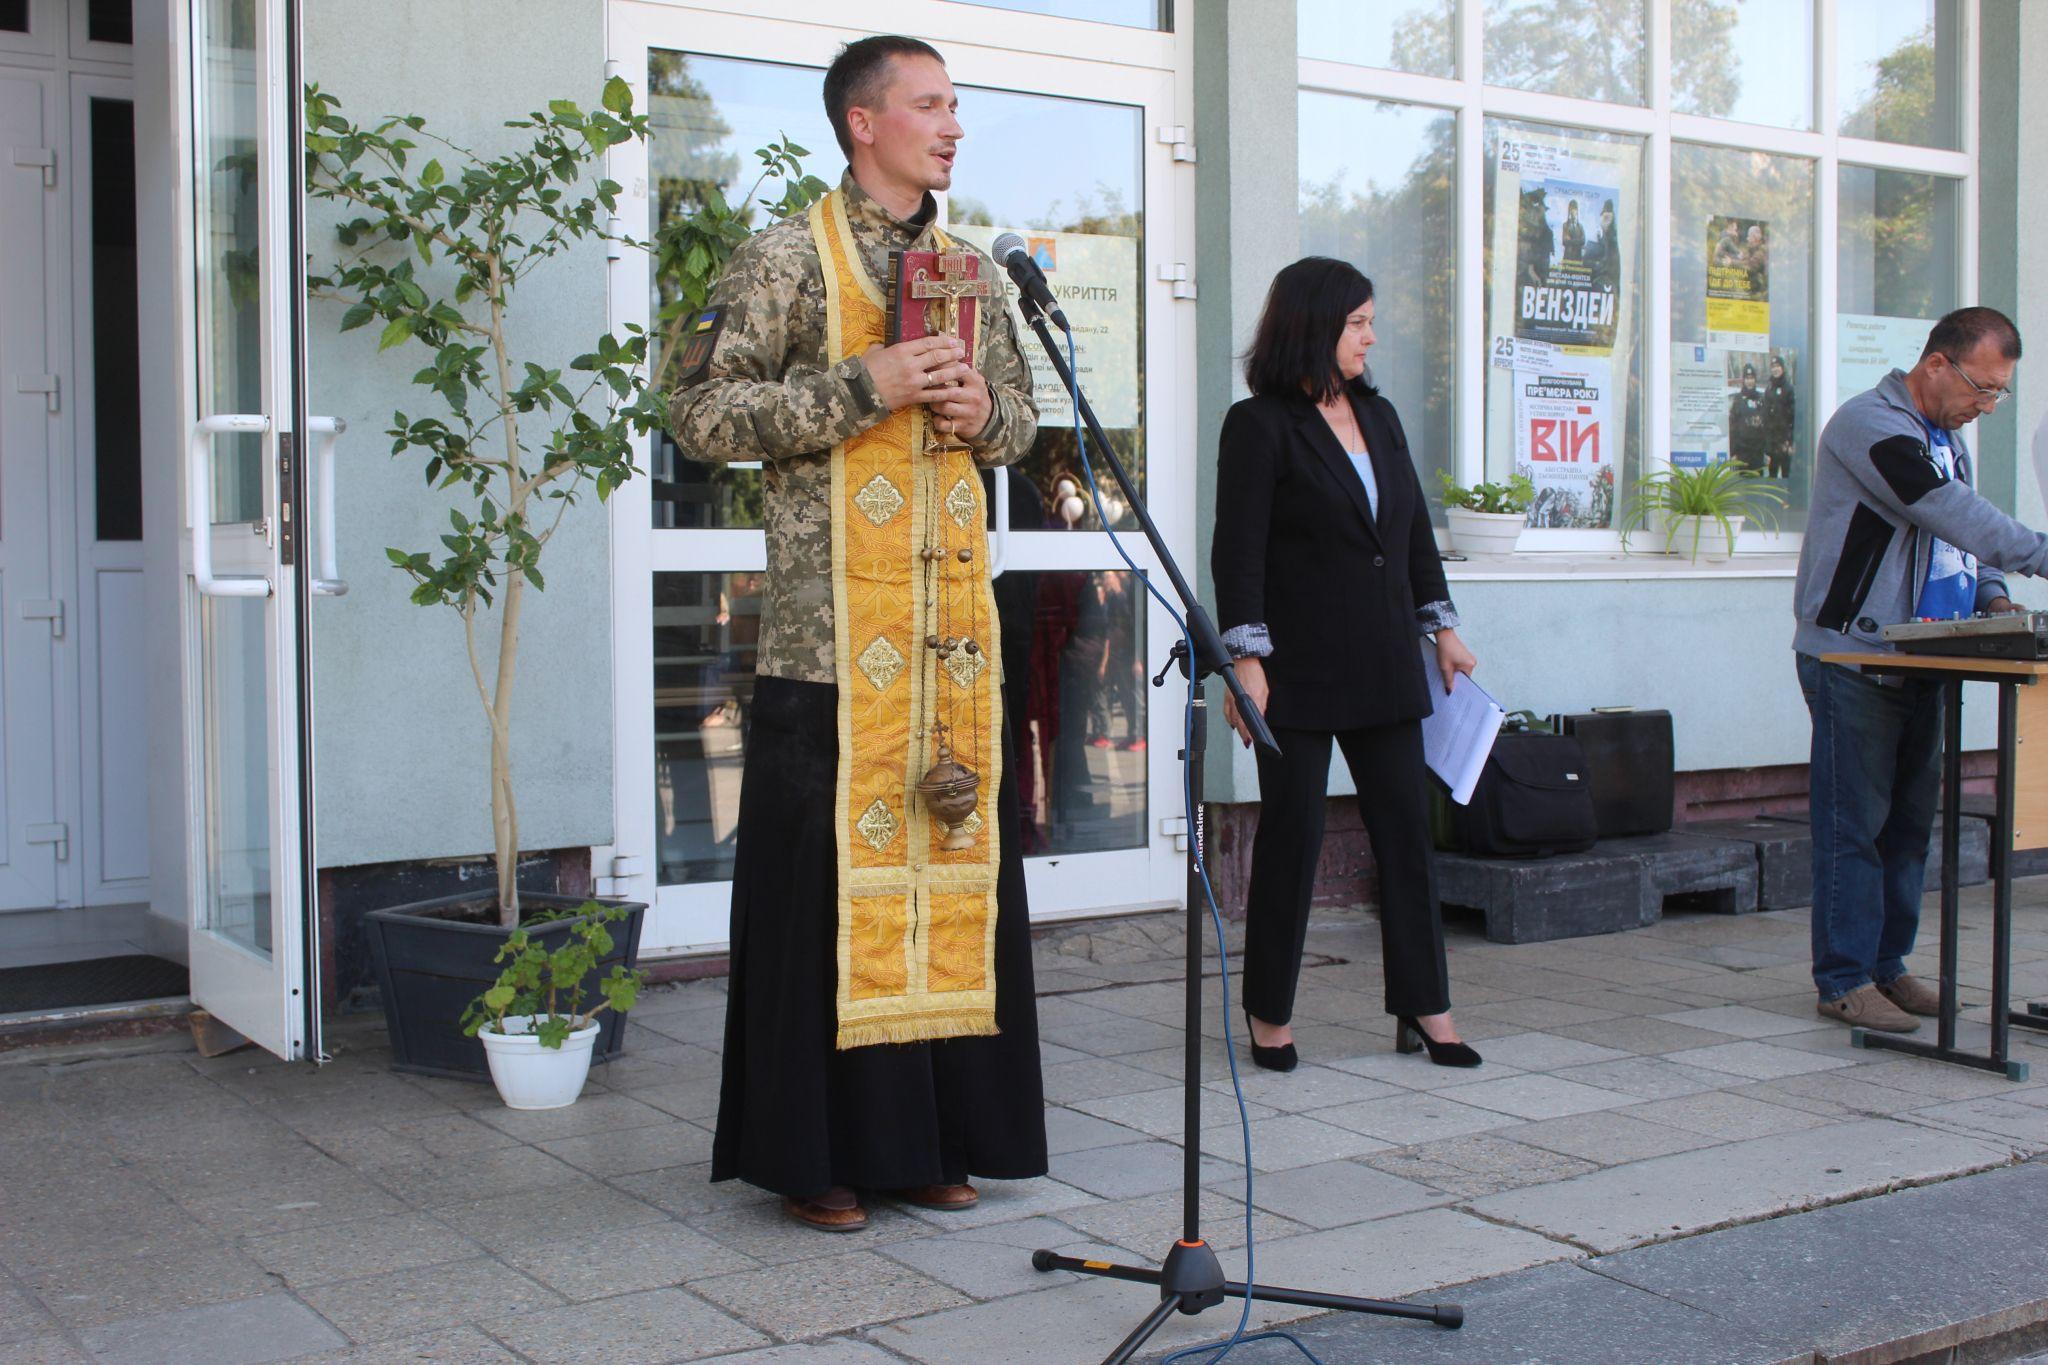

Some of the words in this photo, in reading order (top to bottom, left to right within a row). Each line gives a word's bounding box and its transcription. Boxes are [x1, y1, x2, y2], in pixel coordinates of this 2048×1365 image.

[1502, 141, 1520, 161] 25
[1053, 285, 1117, 302] УКРИТТЯ
[1522, 285, 1614, 330] ВЕНЗДЕЙ
[1072, 325, 1098, 334] айдану,
[1495, 336, 1514, 357] 25
[1573, 389, 1598, 400] РОКУ
[1530, 406, 1600, 463] ВІЙ
